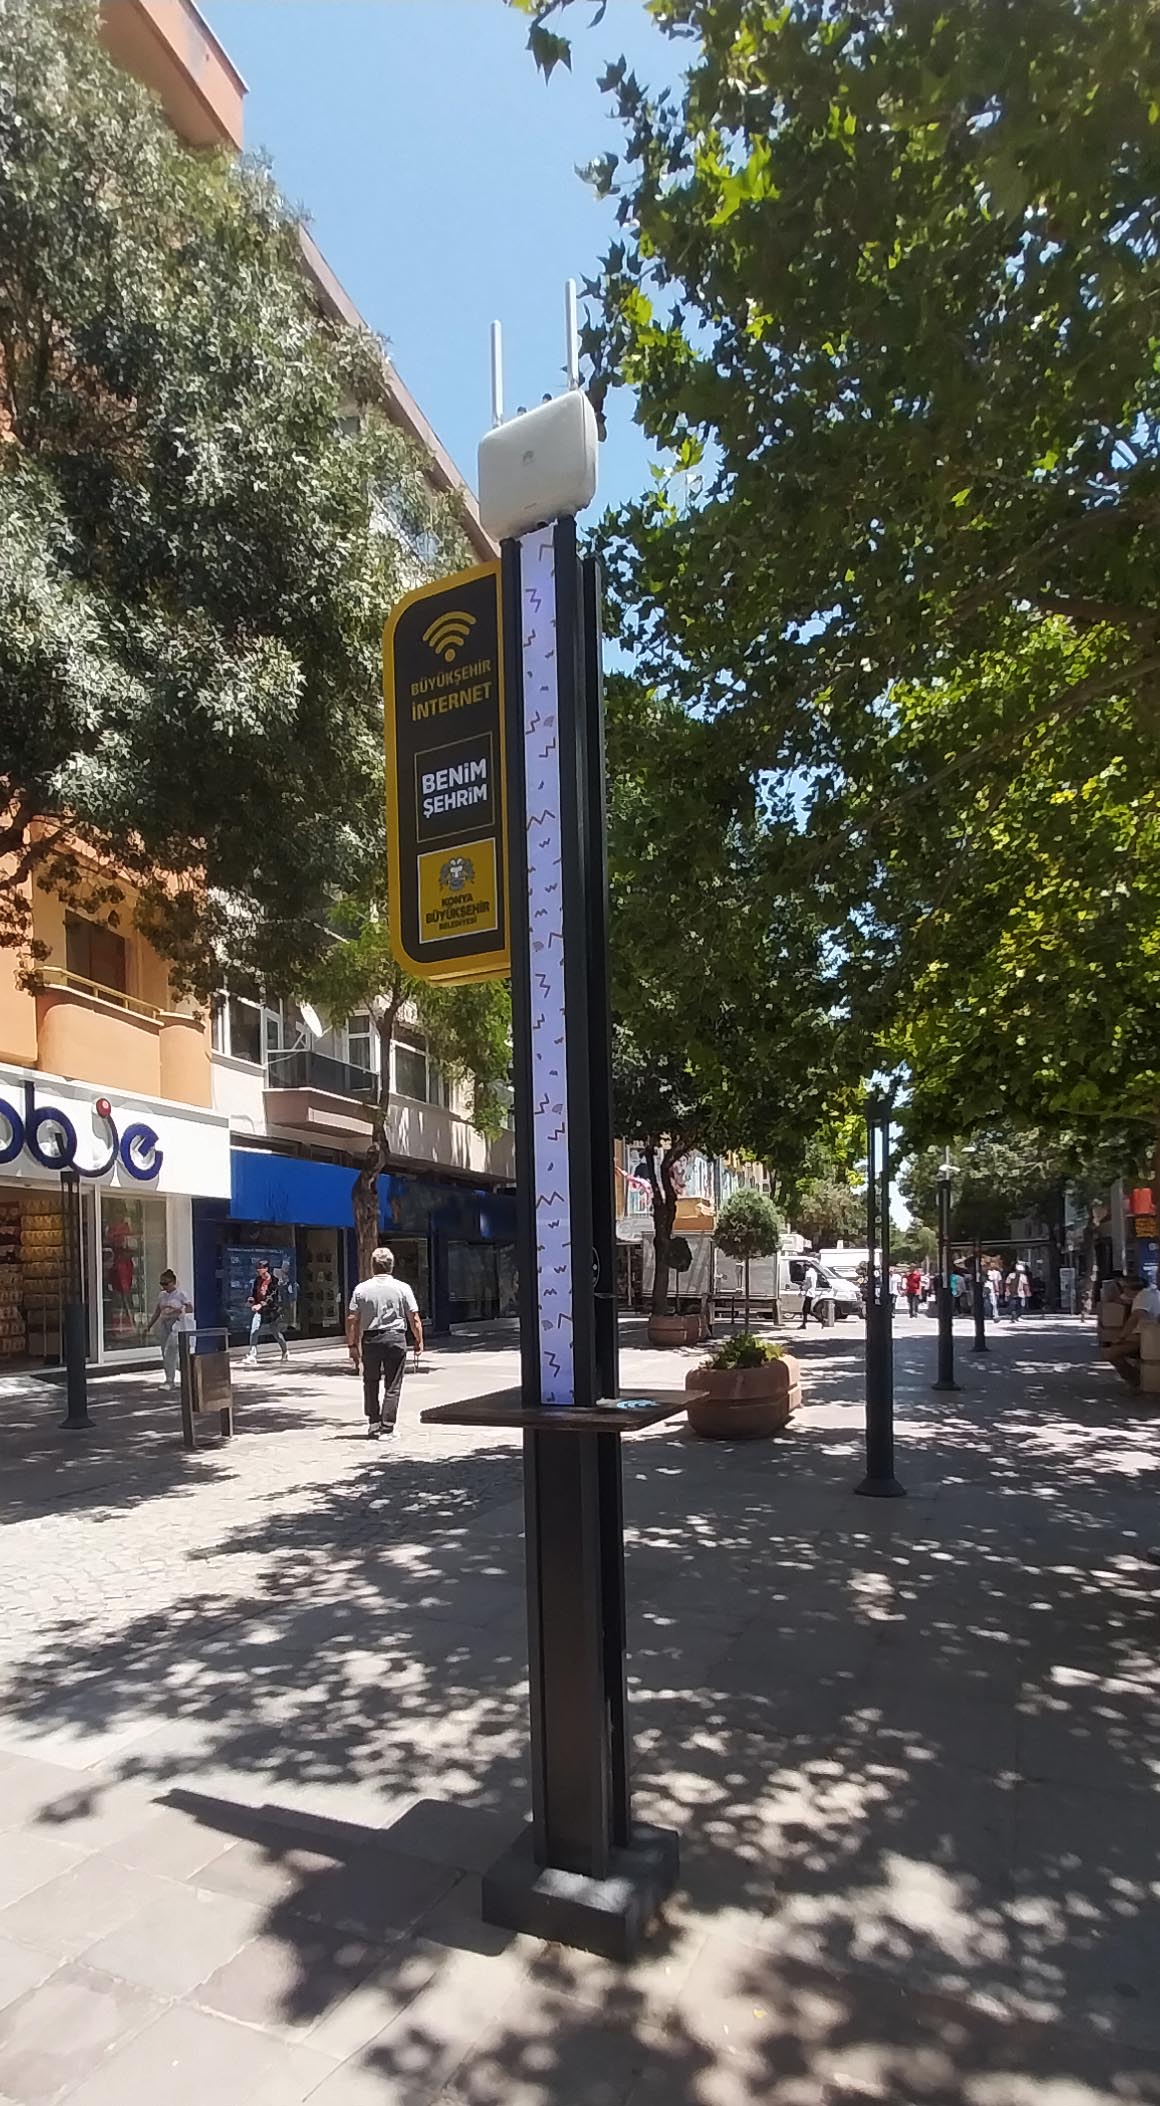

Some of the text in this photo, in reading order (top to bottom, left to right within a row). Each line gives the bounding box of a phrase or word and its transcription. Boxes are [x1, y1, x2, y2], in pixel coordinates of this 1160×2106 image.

[410, 659, 491, 696] BÜYÜKŞEHİR
[412, 681, 492, 721] İNTERNET
[441, 893, 473, 906] KONYA
